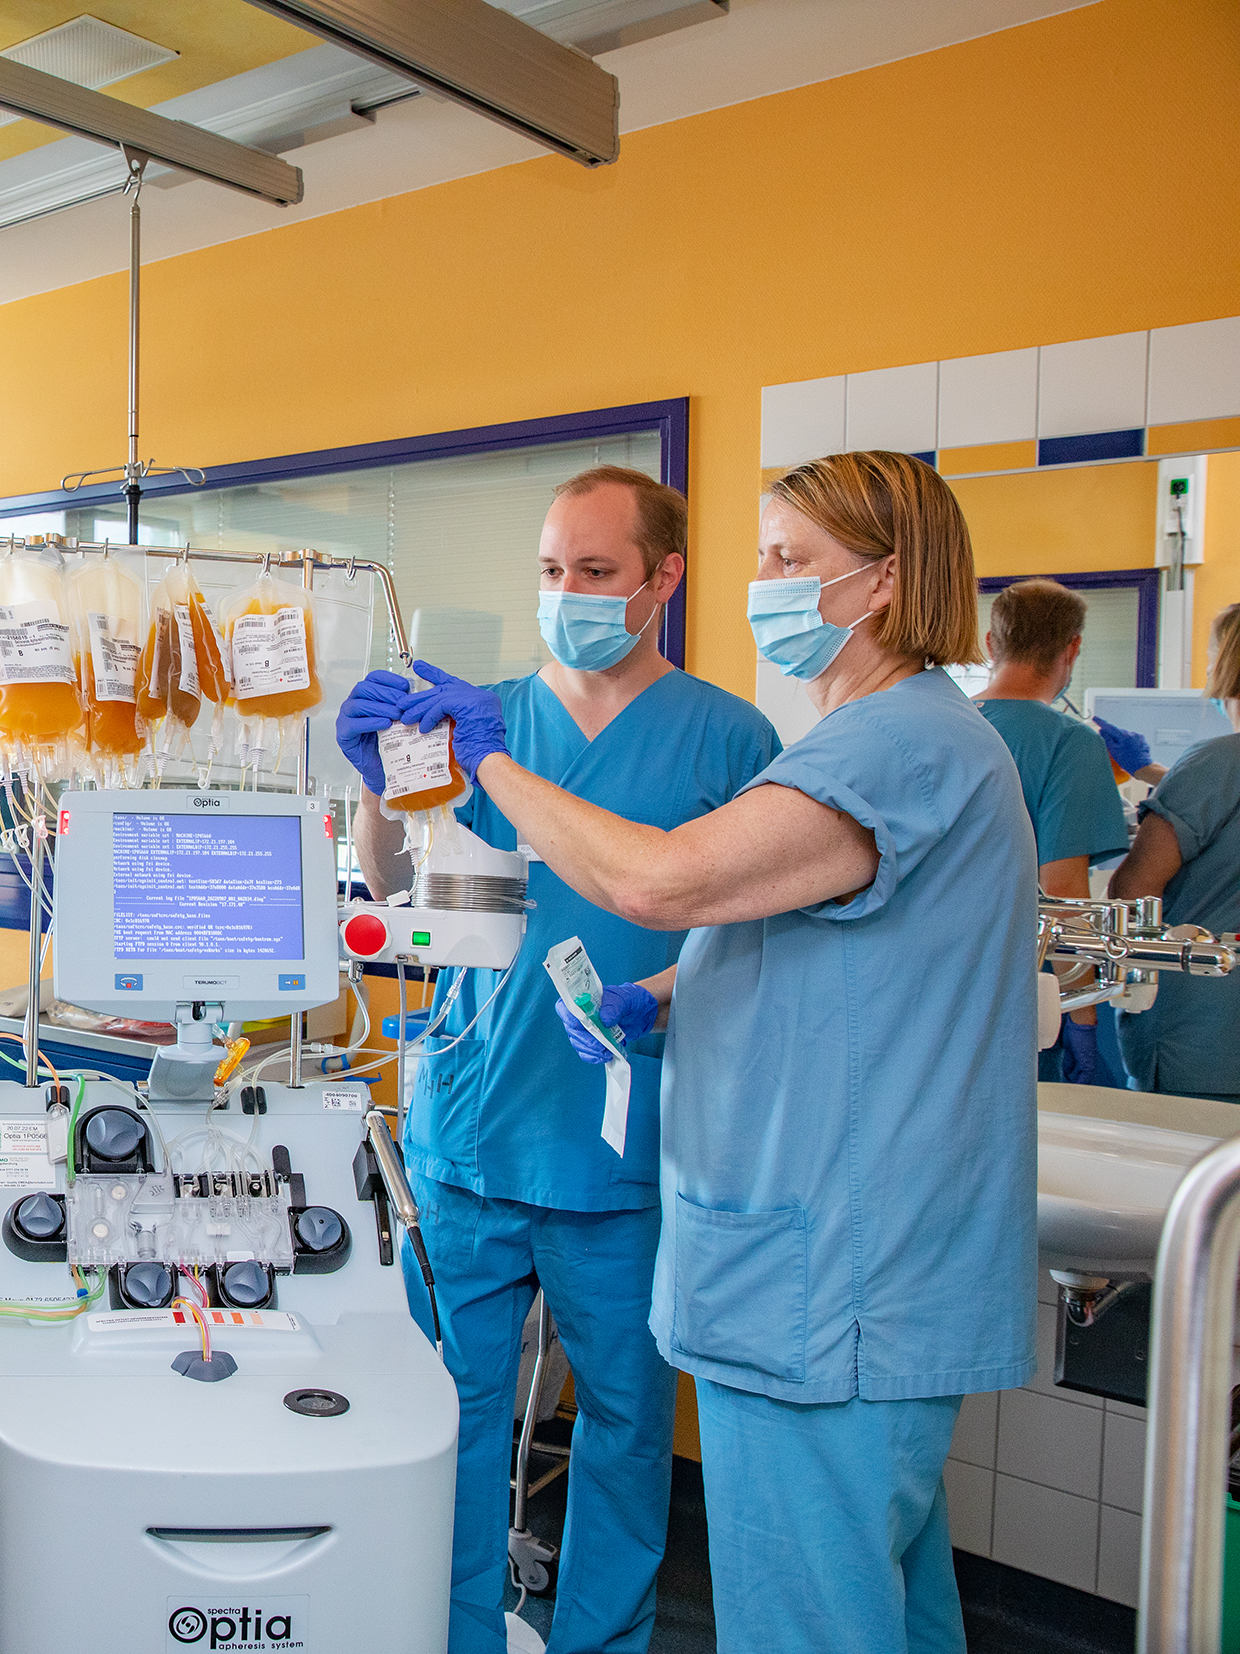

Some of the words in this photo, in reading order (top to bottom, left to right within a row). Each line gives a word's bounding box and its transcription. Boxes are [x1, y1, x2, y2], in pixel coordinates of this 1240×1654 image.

[405, 754, 411, 762] B
[193, 797, 221, 808] Optia
[207, 1607, 241, 1615] spectra
[169, 1606, 292, 1650] Optia
[218, 1642, 266, 1651] apheresis
[271, 1641, 304, 1650] system
